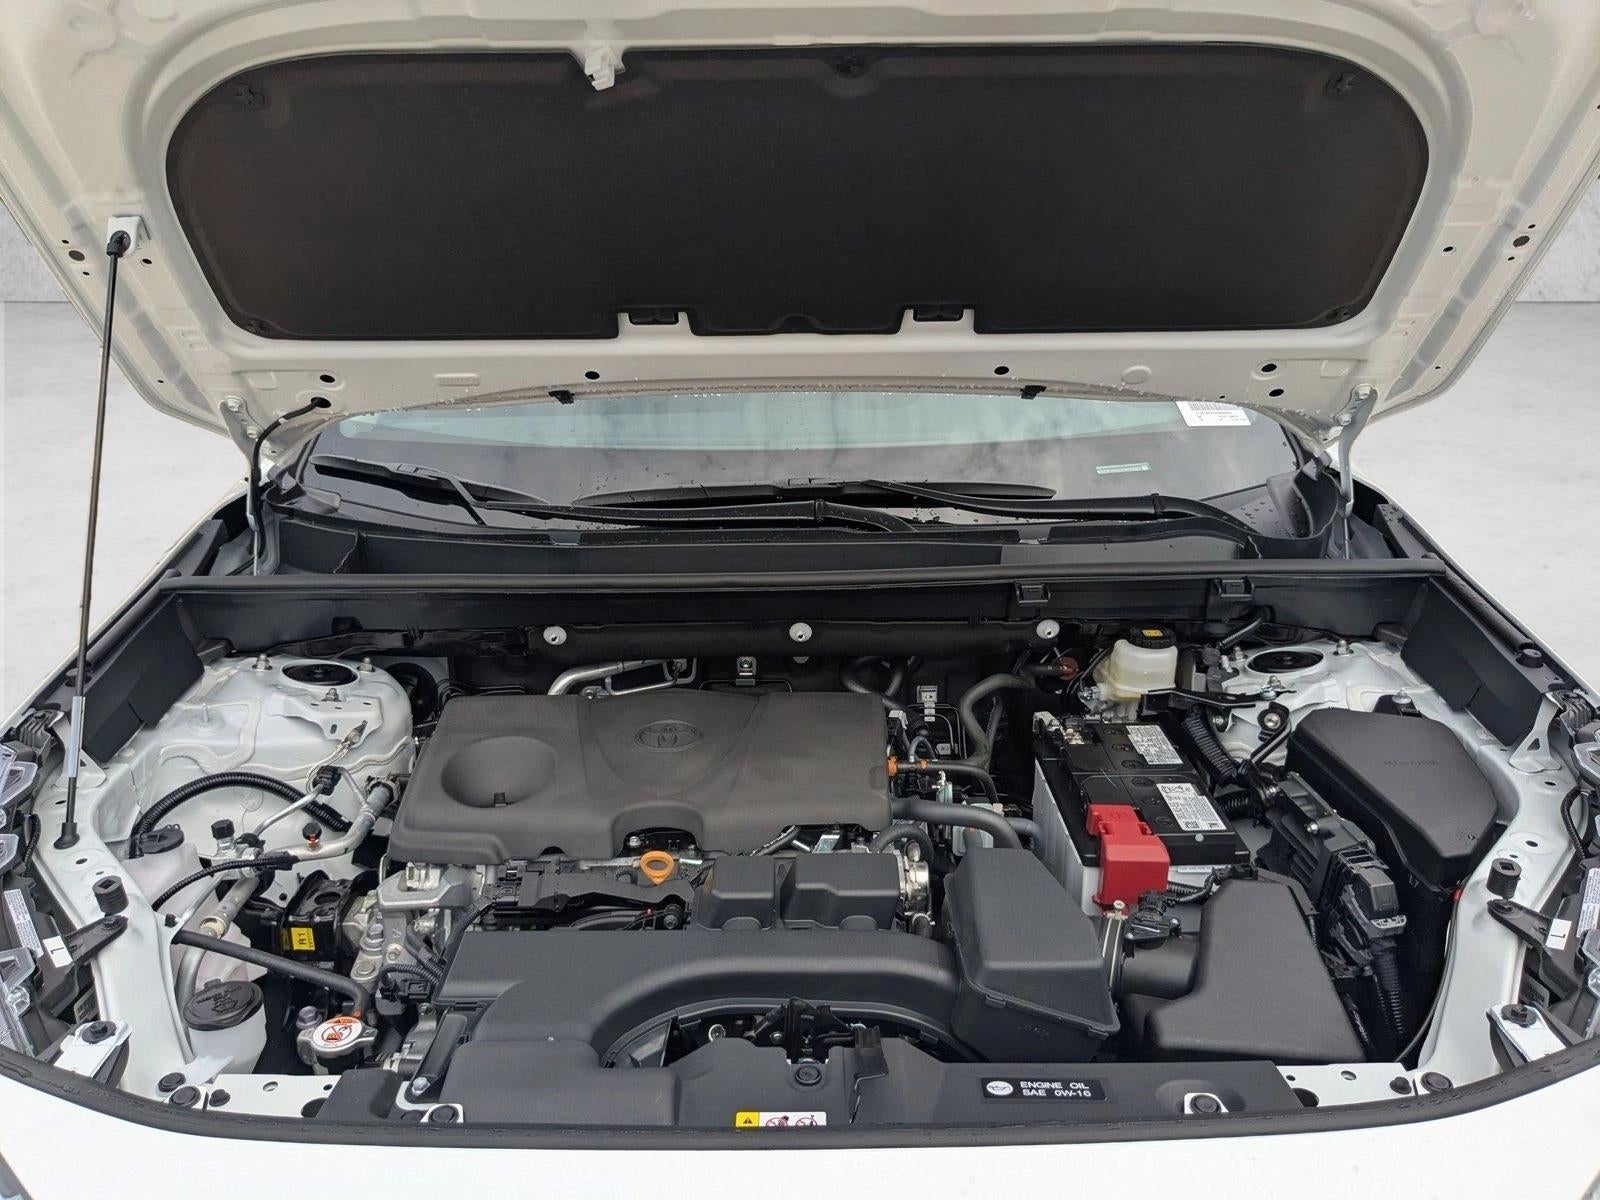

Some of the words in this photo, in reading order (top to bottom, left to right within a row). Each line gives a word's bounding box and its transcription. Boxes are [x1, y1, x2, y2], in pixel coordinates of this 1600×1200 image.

[1019, 1080, 1063, 1090] ENGINE
[1069, 1081, 1090, 1090] OIL
[1021, 1088, 1047, 1097] SAE
[1053, 1089, 1092, 1098] 0W-16
